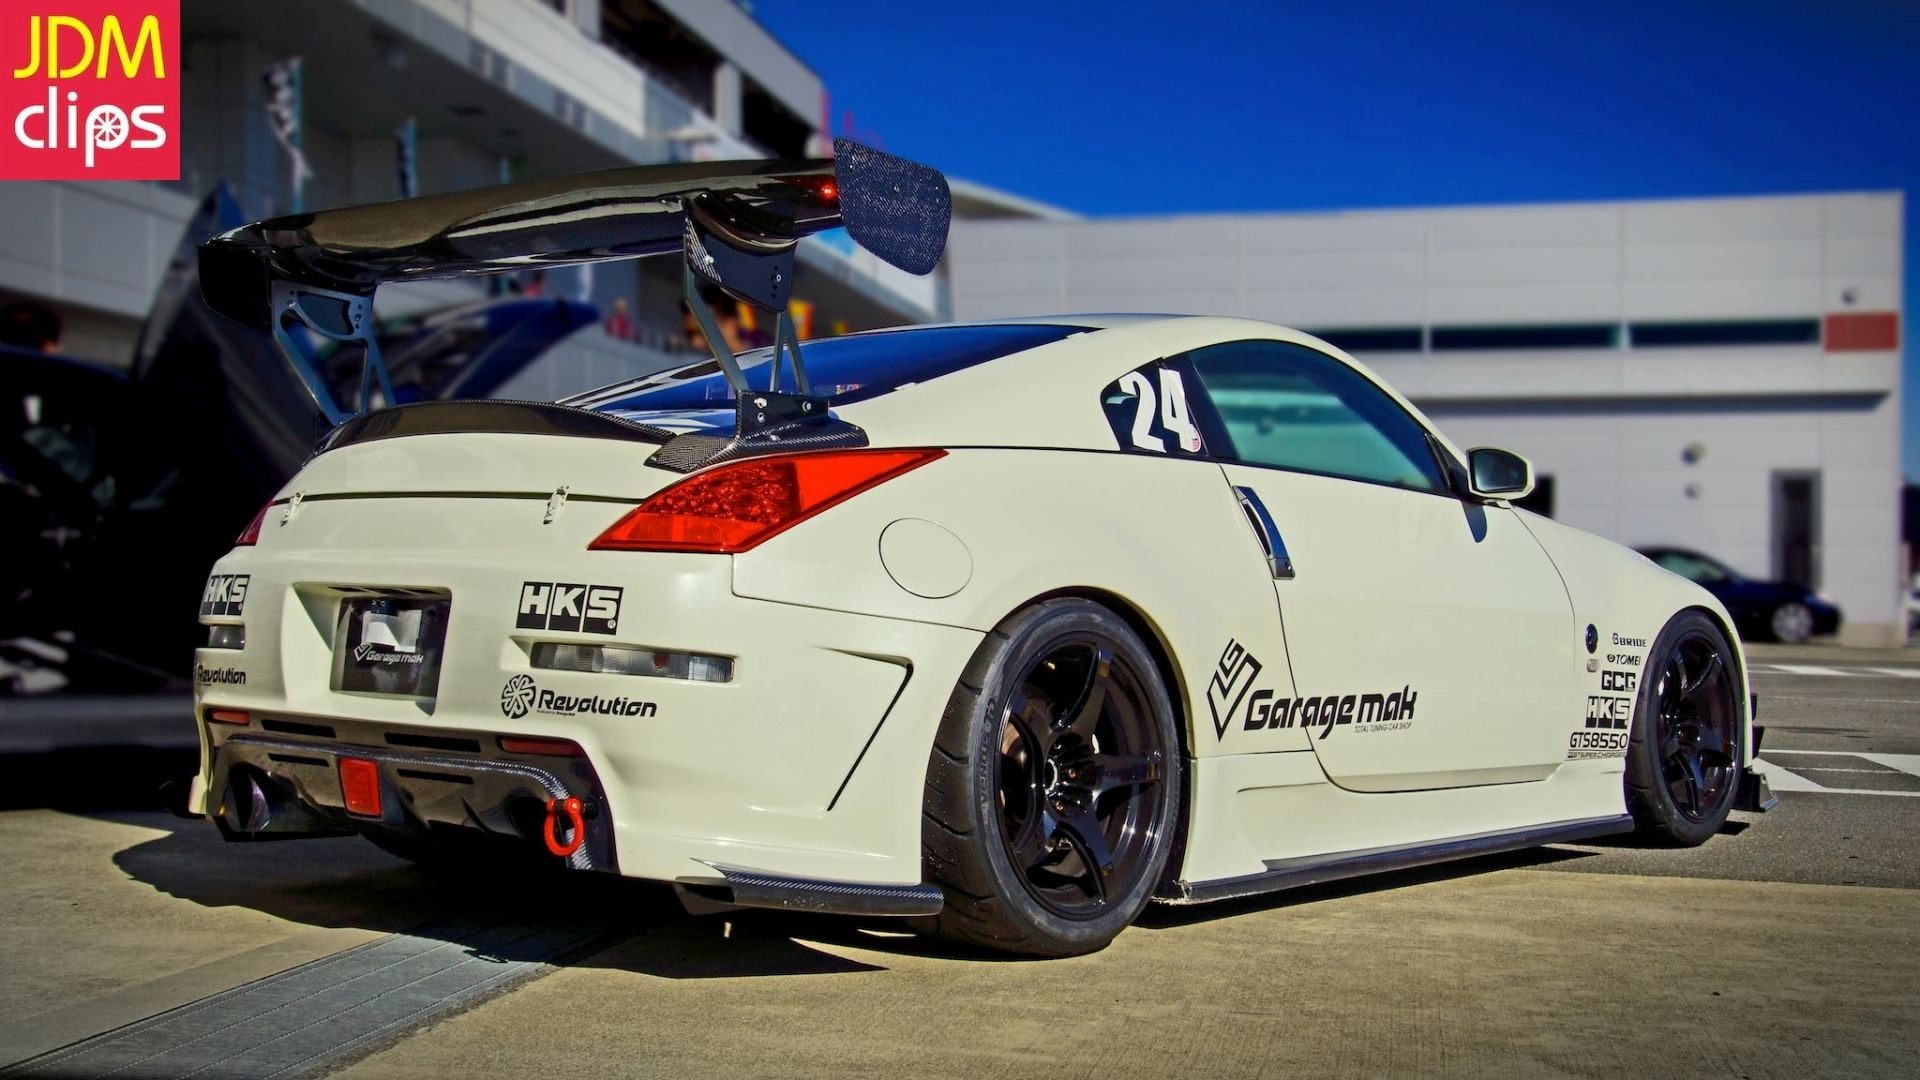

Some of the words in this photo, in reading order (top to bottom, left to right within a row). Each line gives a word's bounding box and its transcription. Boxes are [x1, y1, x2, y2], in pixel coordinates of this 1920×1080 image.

[1118, 368, 1198, 453] 24
[201, 575, 249, 610] HKS
[517, 582, 623, 627] HKS
[198, 664, 247, 685] Revolution
[1602, 670, 1636, 692] GCG
[538, 690, 657, 717] Revolution
[1586, 696, 1630, 724] HKS
[1569, 732, 1629, 749] GTS8550
